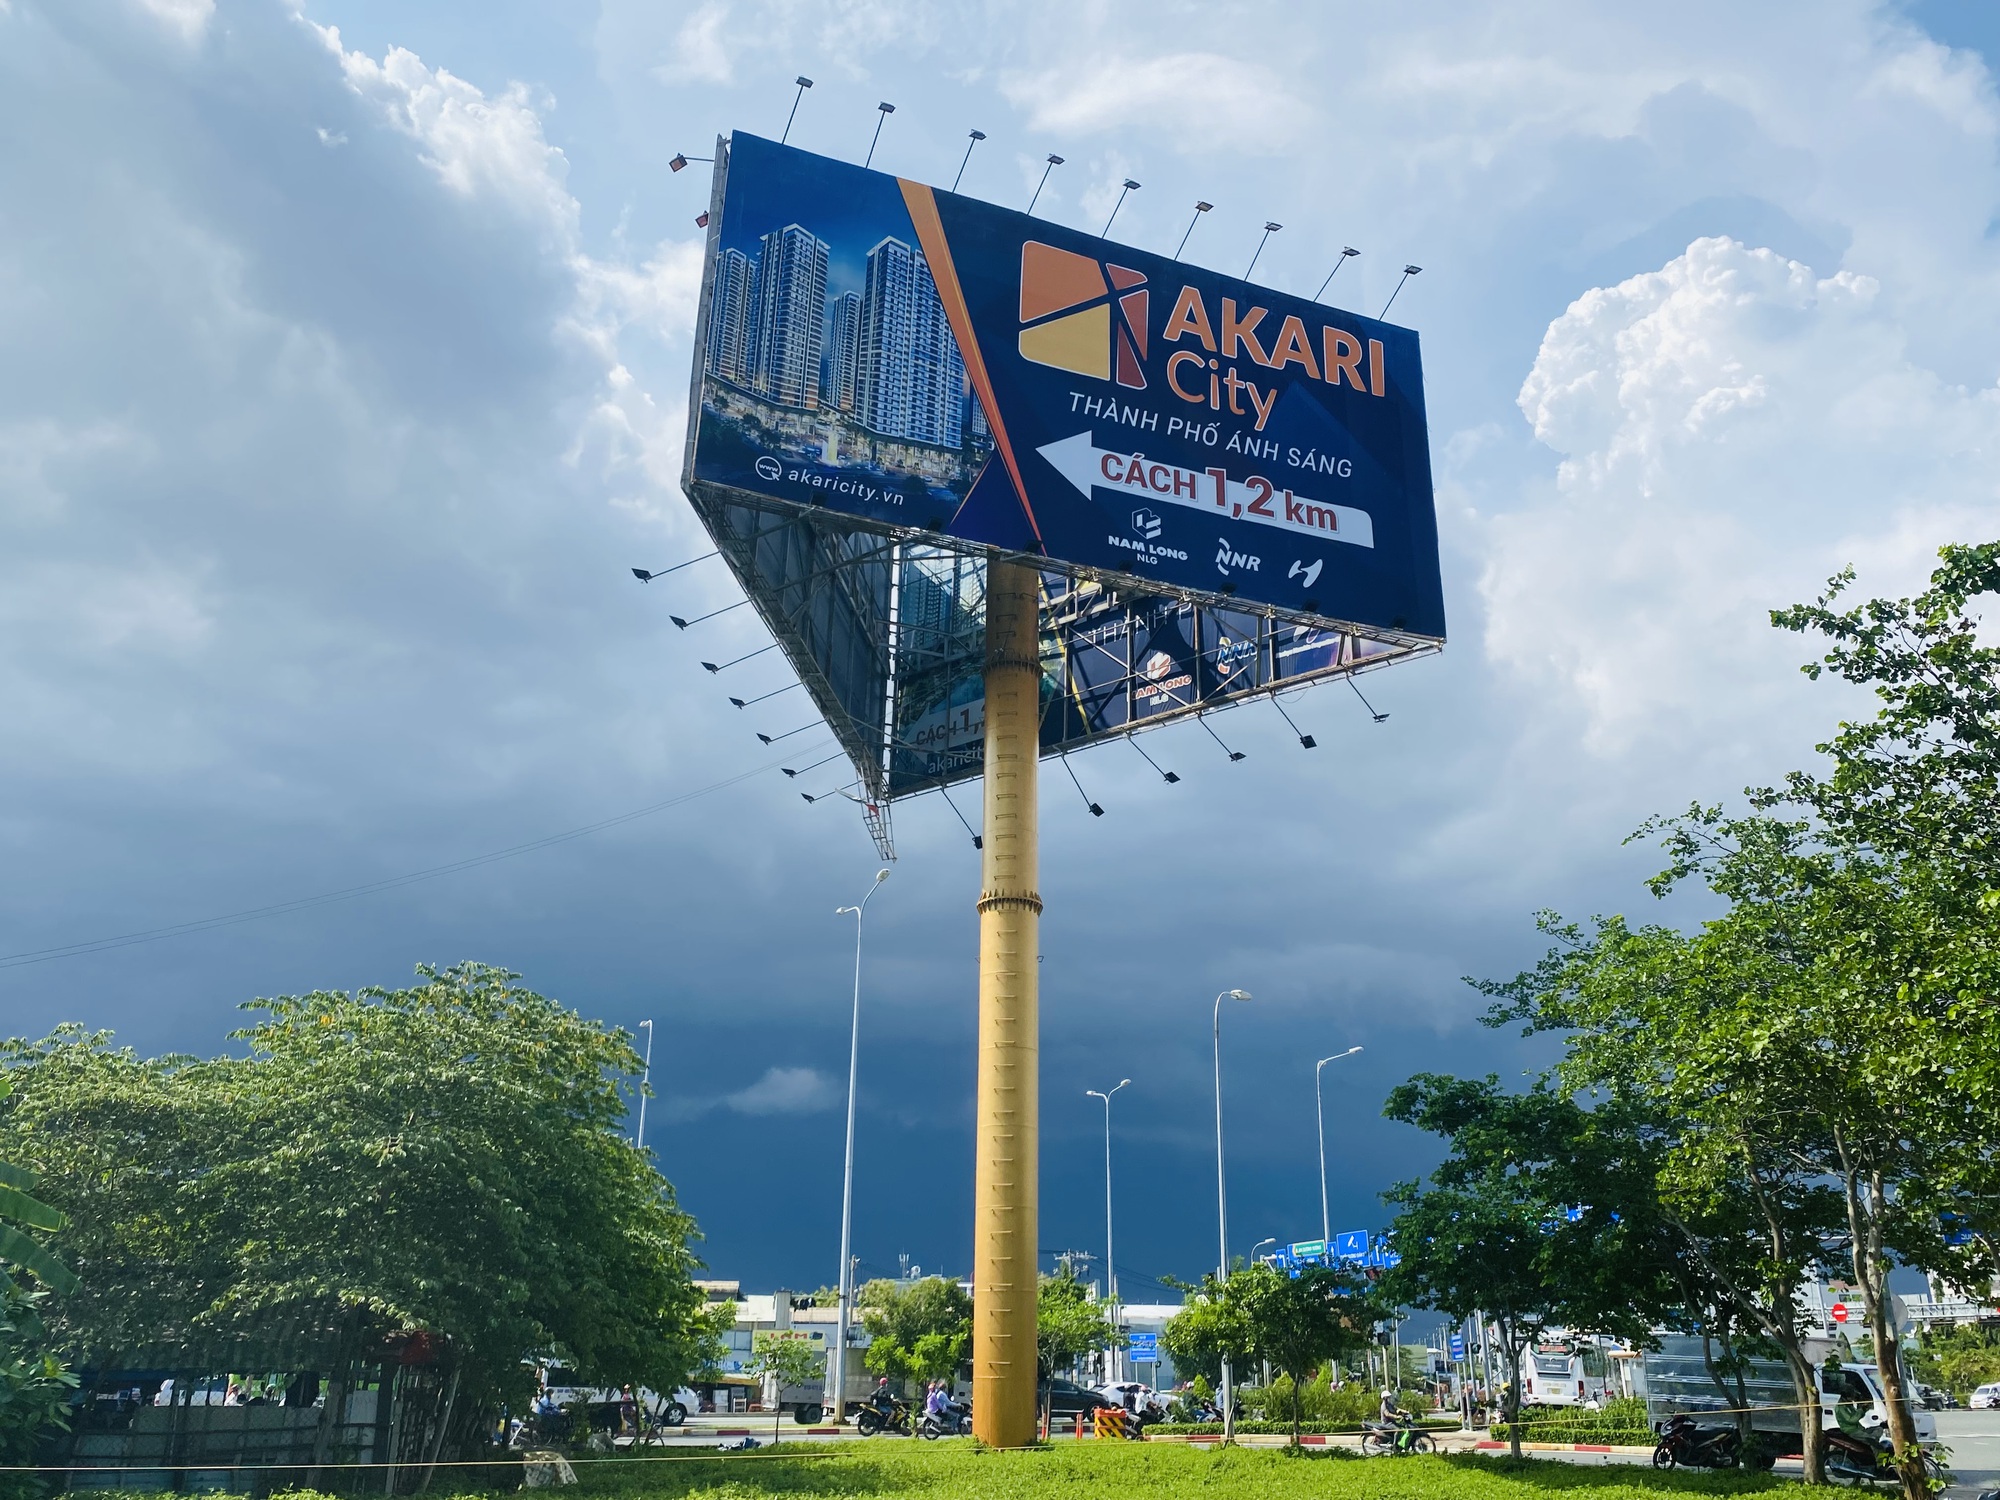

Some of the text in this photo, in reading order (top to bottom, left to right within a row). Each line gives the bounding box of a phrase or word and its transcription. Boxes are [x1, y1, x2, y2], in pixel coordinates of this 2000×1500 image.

[1163, 285, 1385, 397] AKARI
[1167, 350, 1277, 431] City
[1070, 391, 1352, 478] THÀNH PHỐ ÁNH SÁNG
[788, 469, 904, 505] akaricity.vn
[1101, 452, 1339, 533] CÁCH 1,2 km
[1108, 535, 1188, 561] NAM LONG
[1136, 553, 1158, 565] NLG
[1215, 547, 1261, 572] NNR
